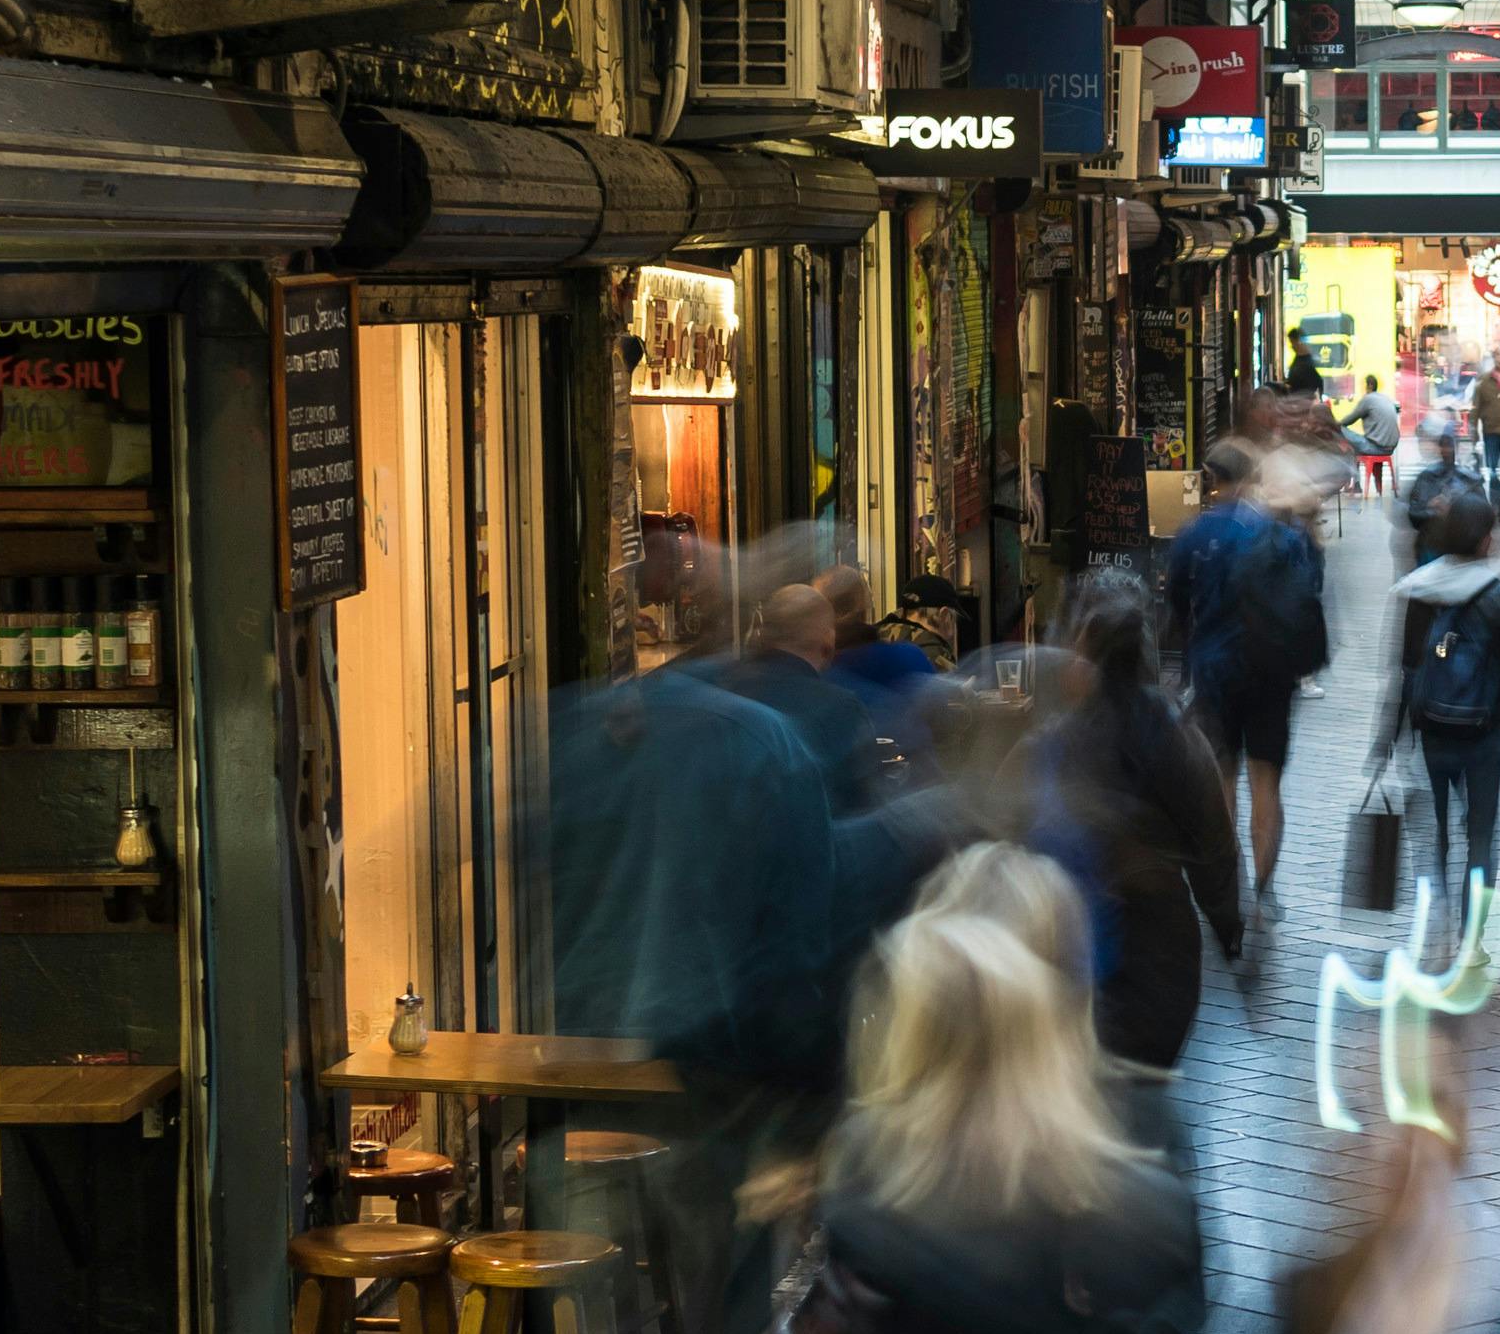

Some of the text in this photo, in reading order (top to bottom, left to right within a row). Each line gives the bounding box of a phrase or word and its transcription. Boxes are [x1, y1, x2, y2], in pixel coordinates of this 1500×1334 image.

[1297, 43, 1346, 55] LUSTRE
[1170, 61, 1187, 76] in
[1202, 50, 1246, 72] rush
[888, 114, 1017, 152] FOKUS
